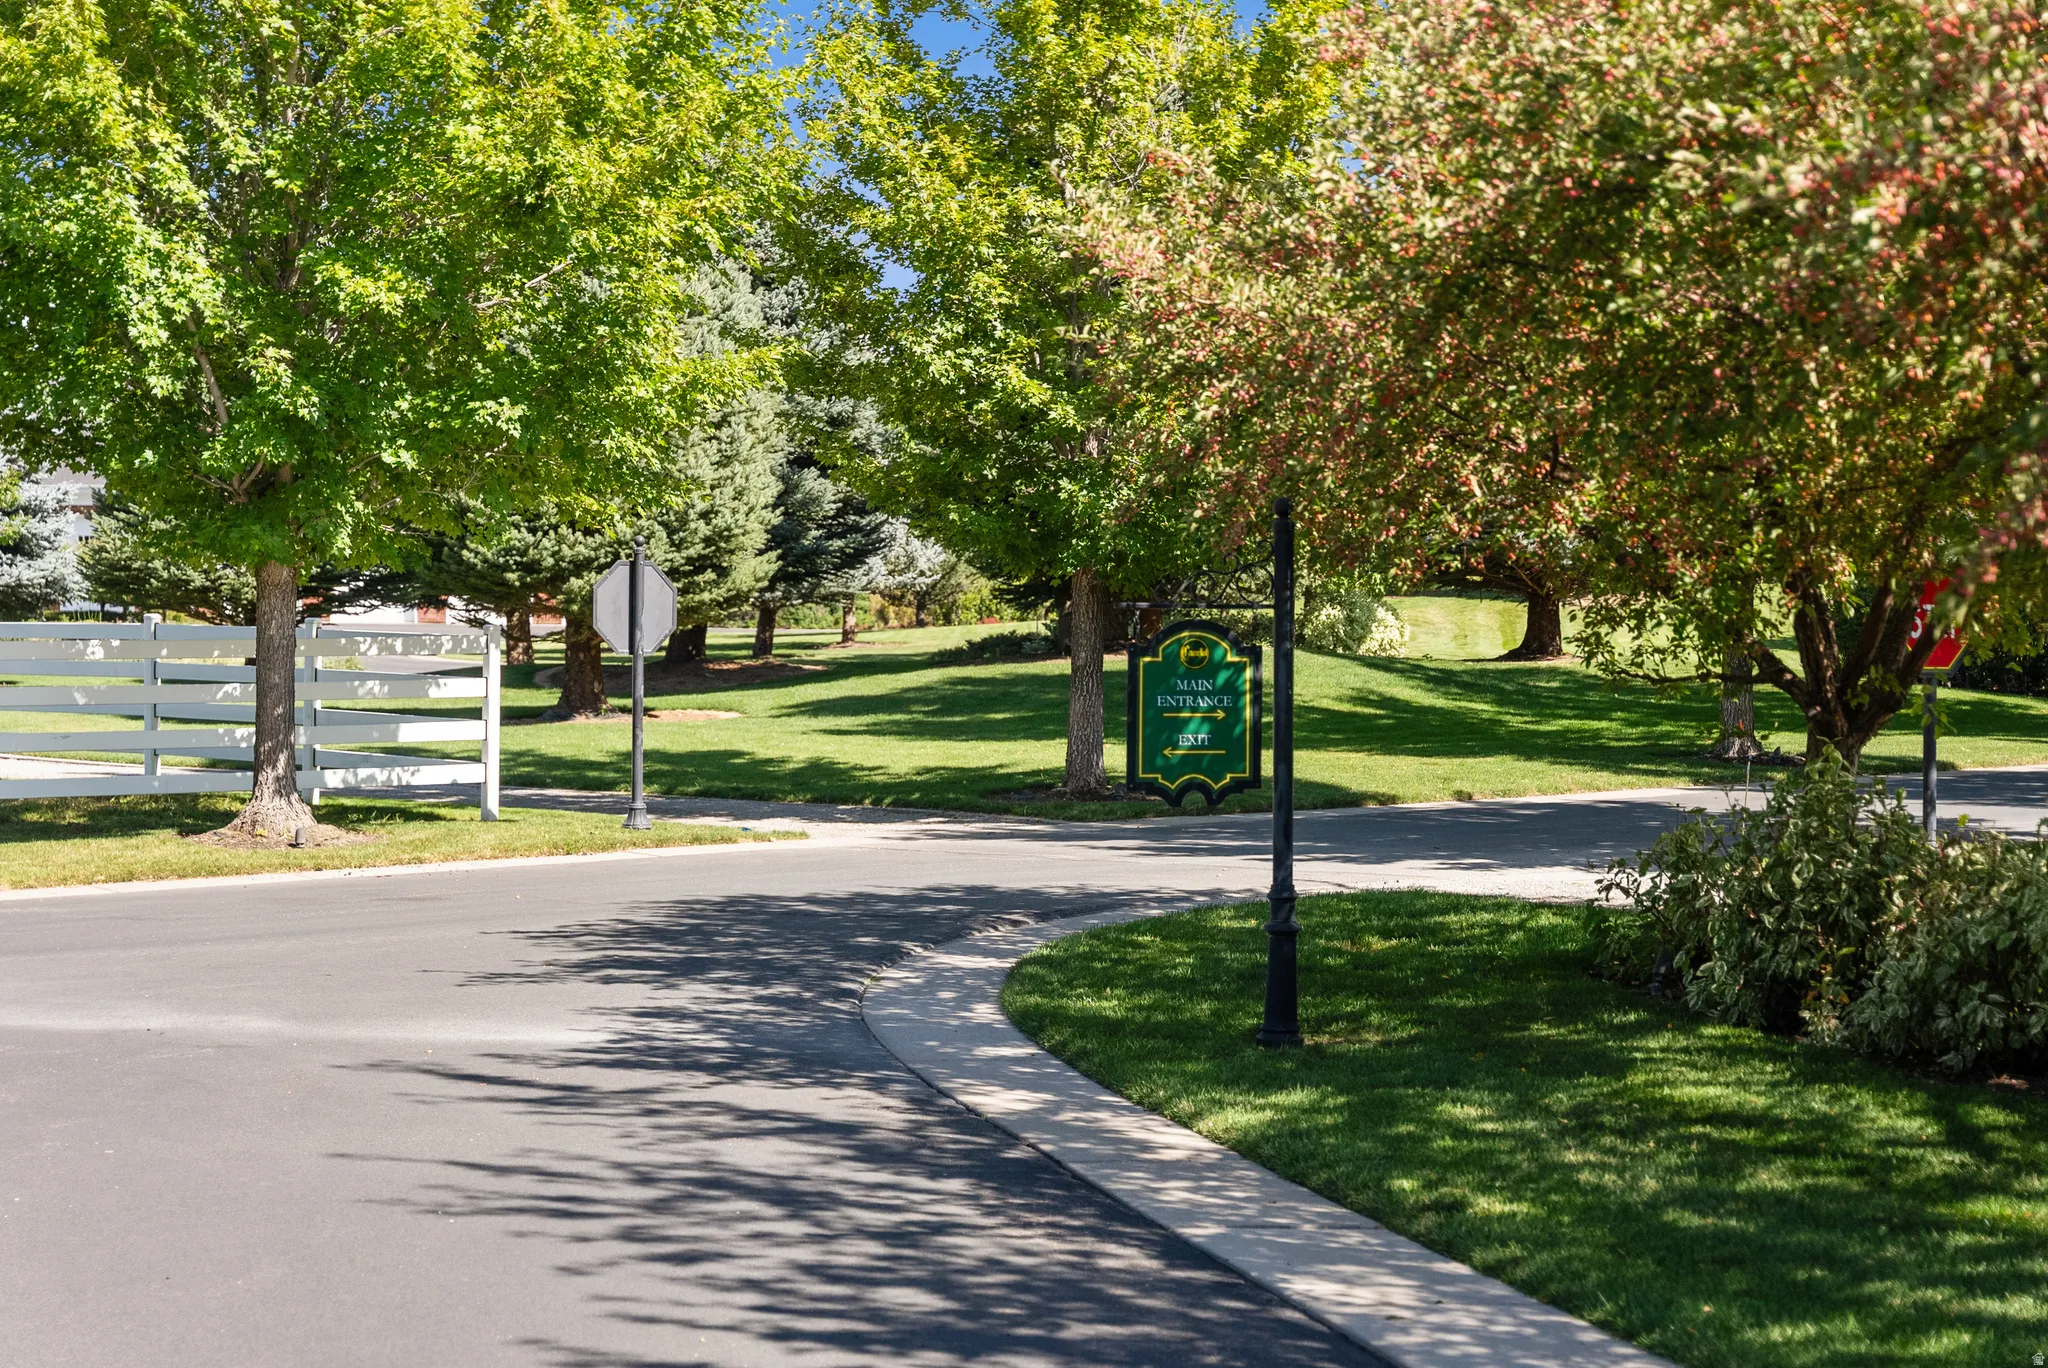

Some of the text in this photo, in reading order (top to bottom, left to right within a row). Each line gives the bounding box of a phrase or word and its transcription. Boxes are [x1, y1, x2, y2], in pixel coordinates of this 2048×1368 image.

[1176, 679, 1213, 691] MAIN
[1156, 695, 1233, 707] ENTRANCE
[1178, 734, 1212, 746] EXIT
